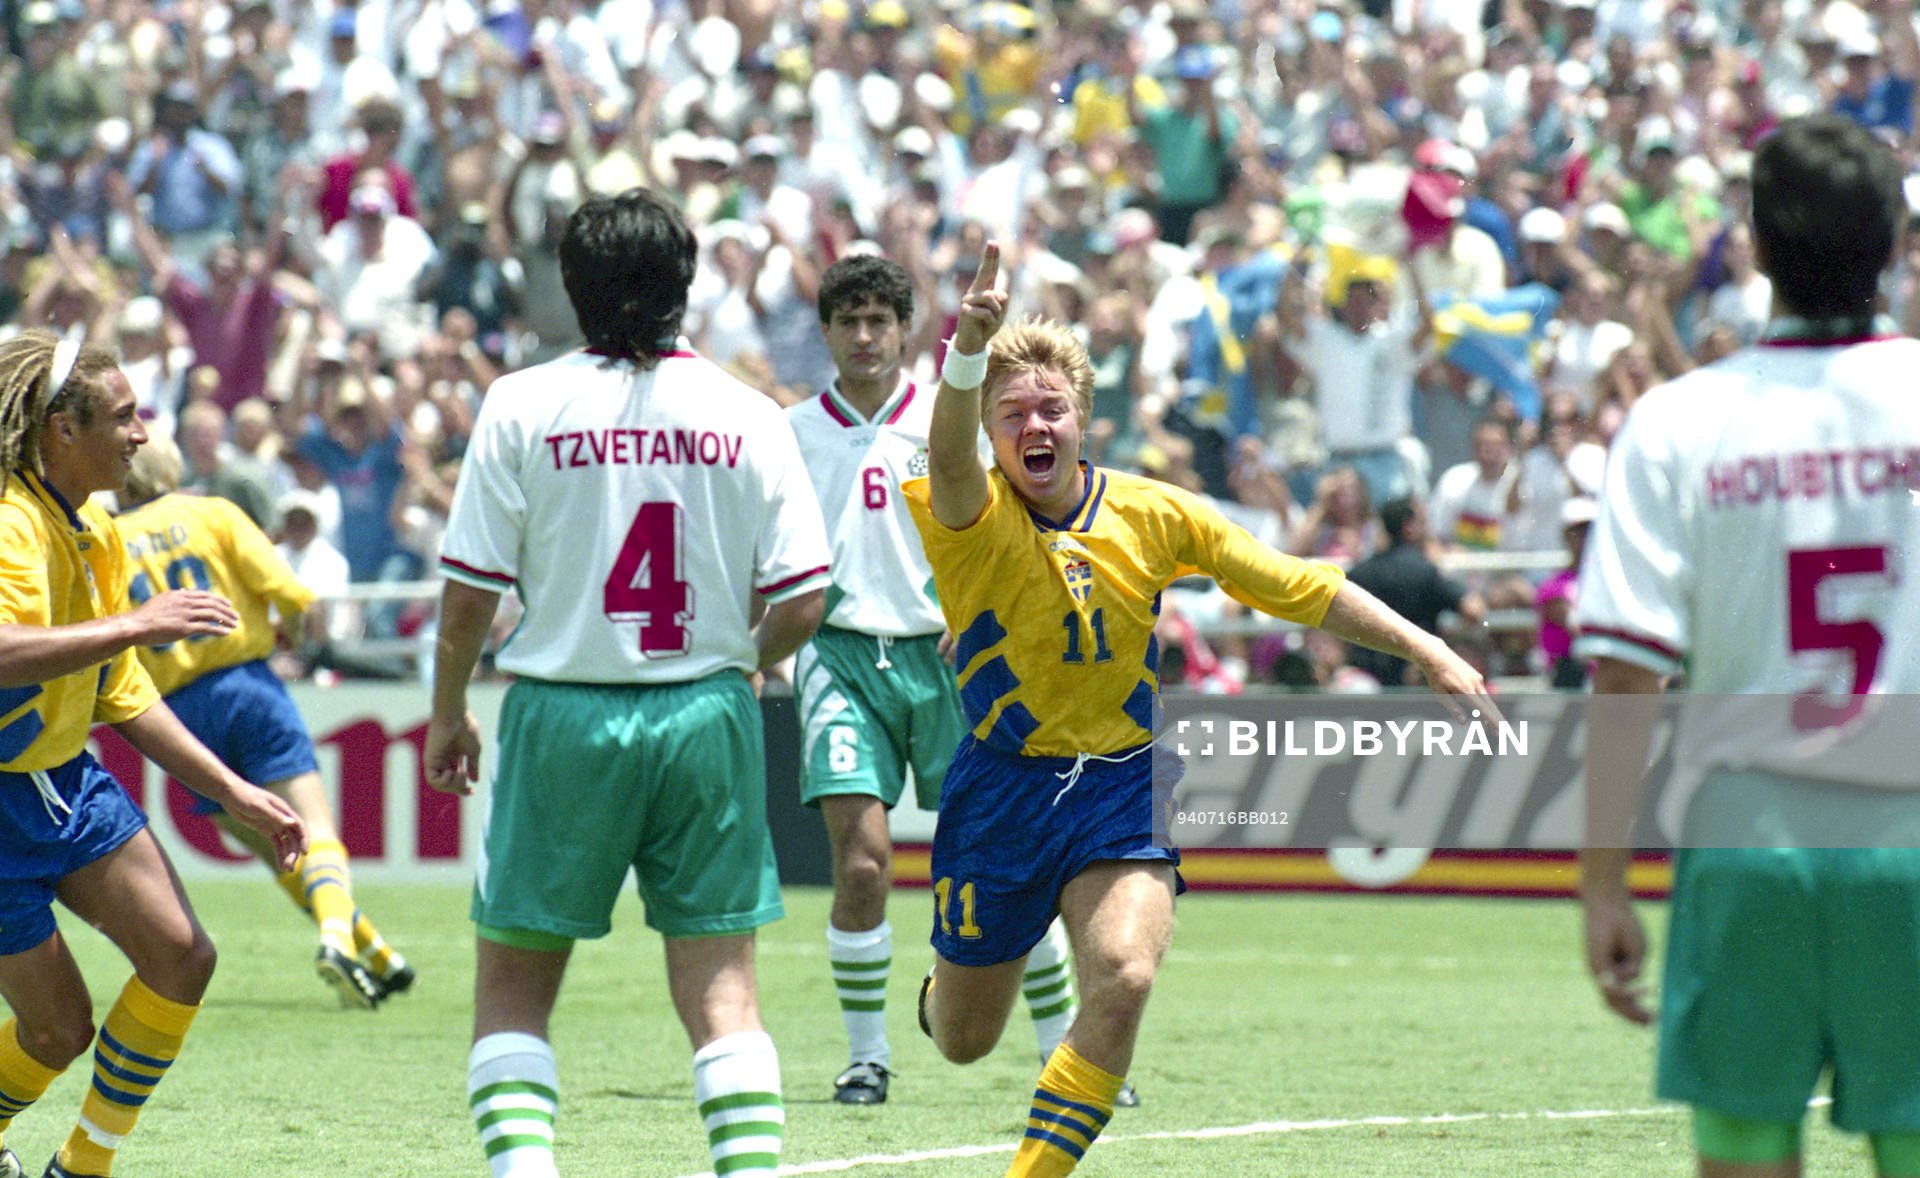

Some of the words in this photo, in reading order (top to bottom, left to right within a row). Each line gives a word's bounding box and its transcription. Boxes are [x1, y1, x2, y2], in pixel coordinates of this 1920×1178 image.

[545, 428, 743, 471] TZVETANOV
[862, 467, 887, 510] 6
[603, 501, 696, 660] 4
[1062, 607, 1114, 665] 11
[1787, 543, 1896, 737] 5
[829, 725, 858, 773] 6
[934, 876, 982, 940] 11
